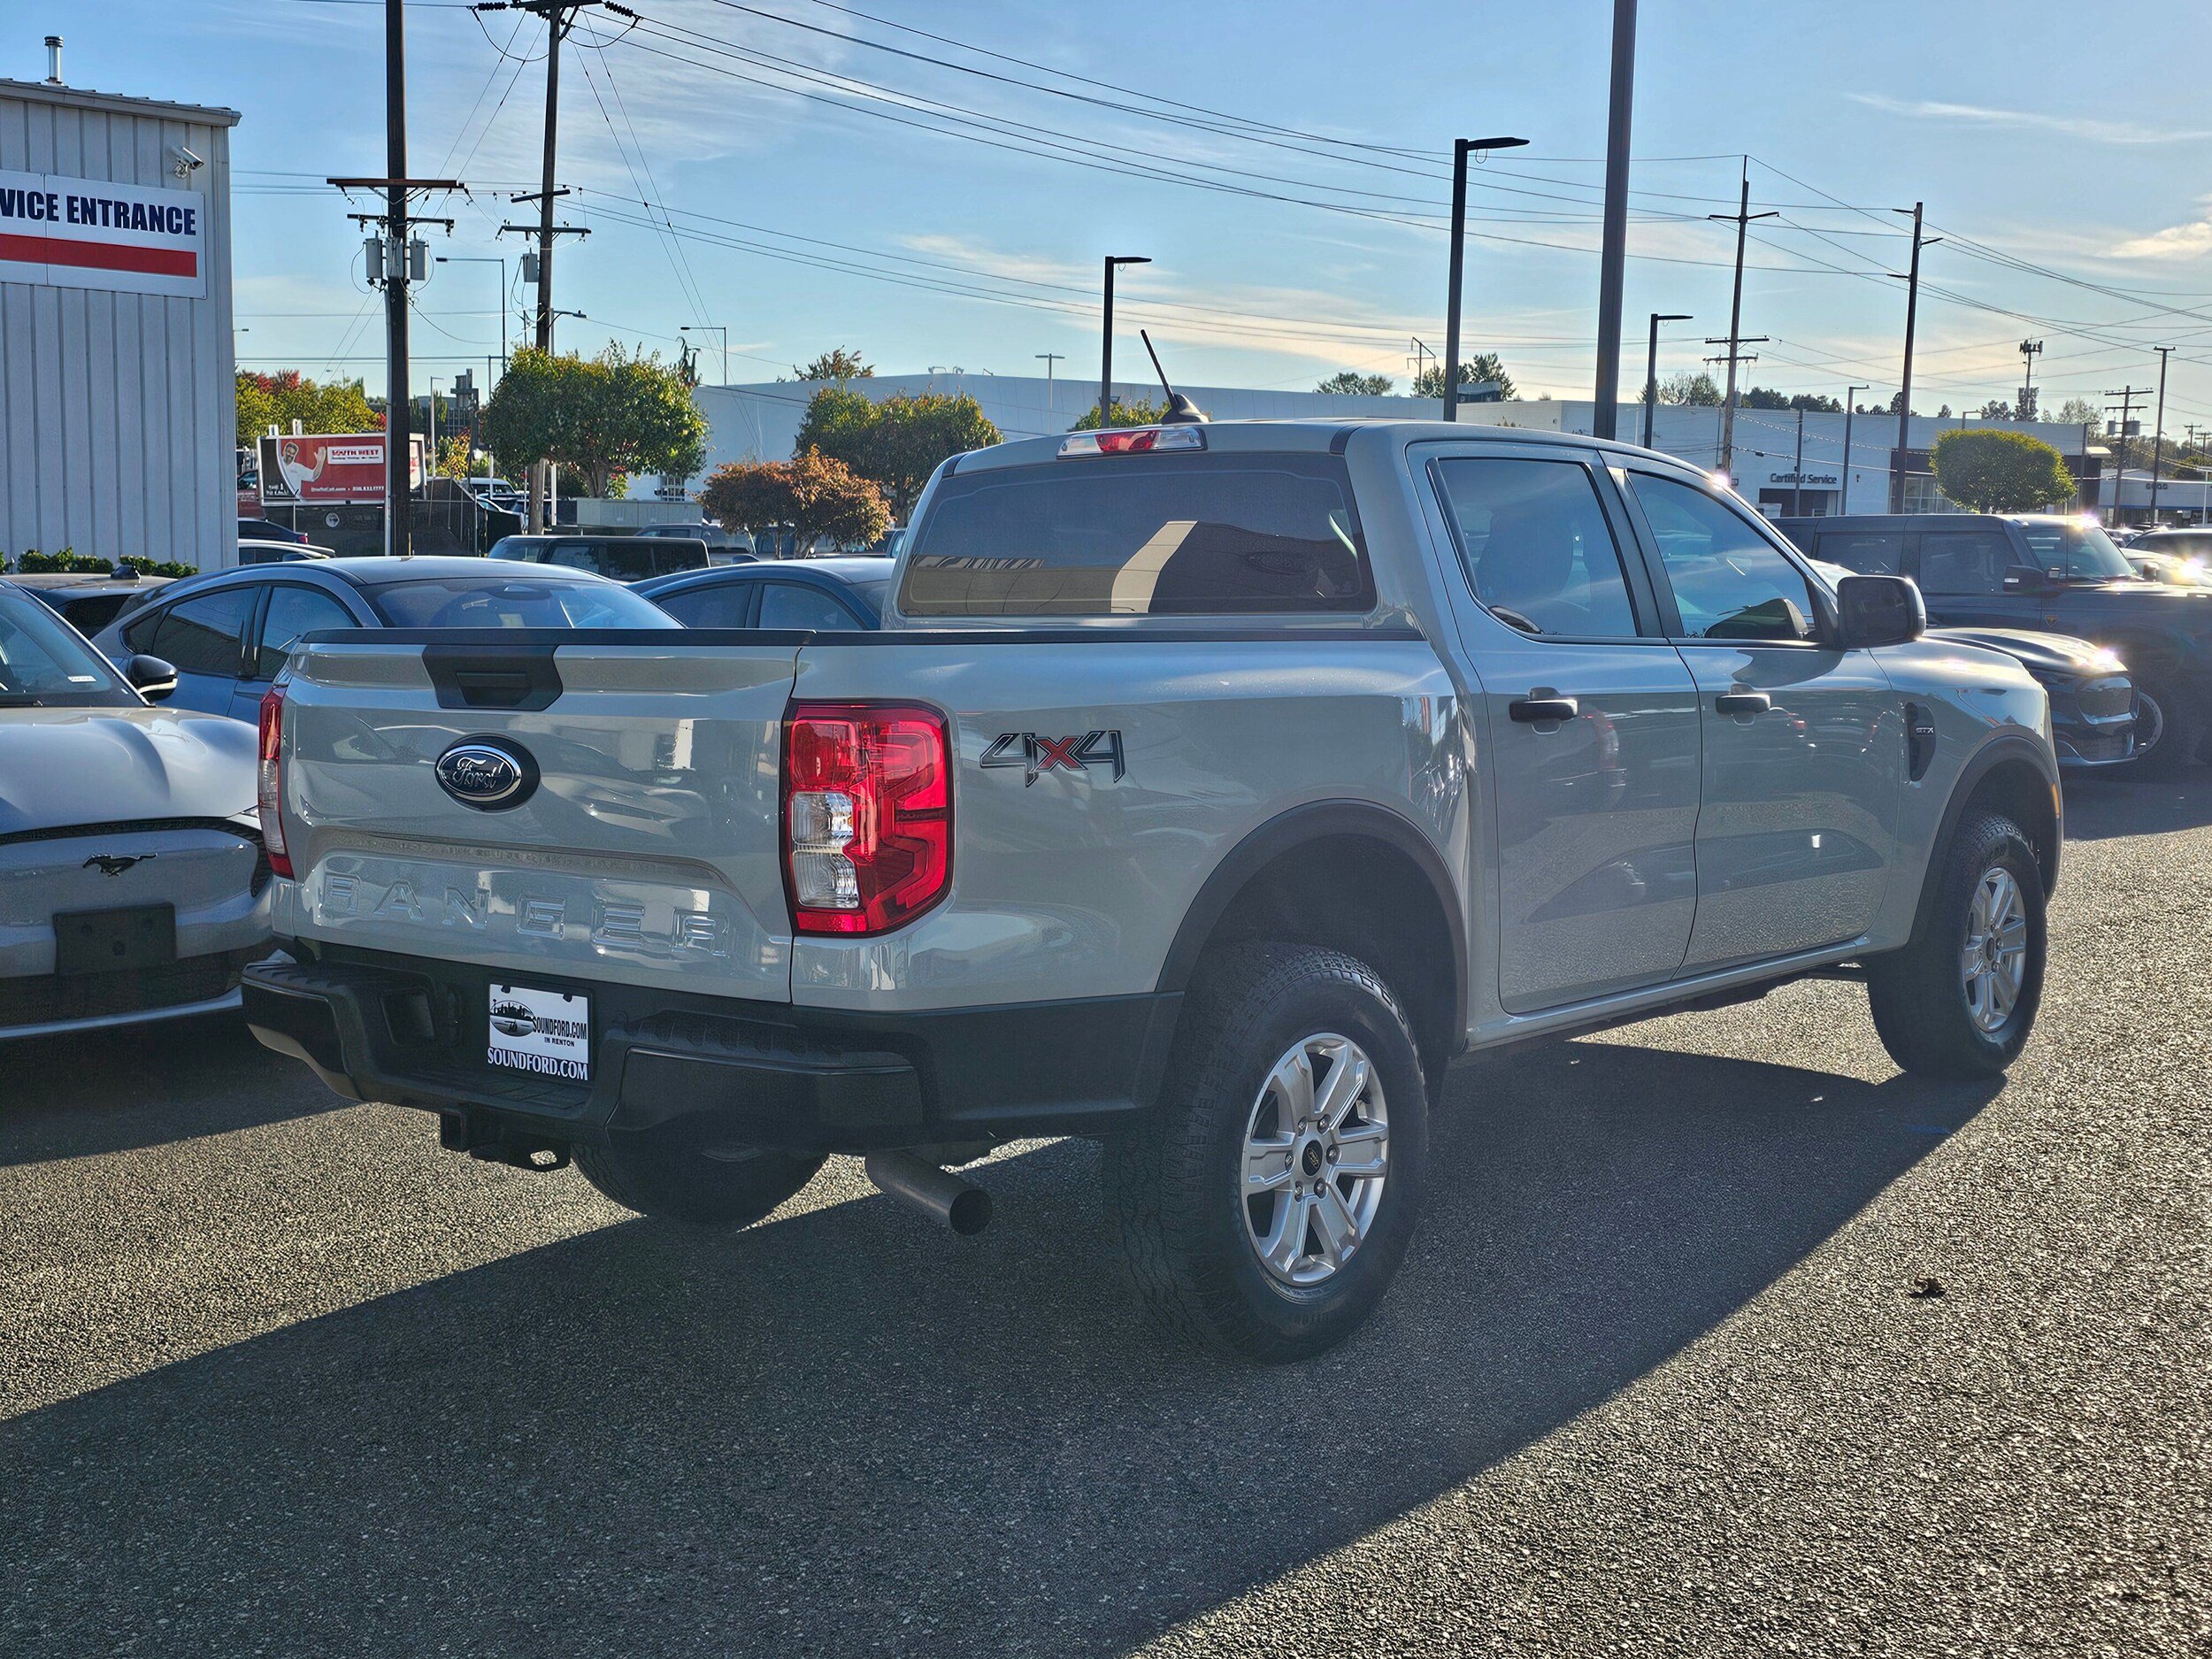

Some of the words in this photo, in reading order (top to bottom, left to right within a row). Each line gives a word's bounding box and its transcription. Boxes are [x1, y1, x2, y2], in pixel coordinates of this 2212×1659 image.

[66, 195, 196, 236] ENTRANCE
[1770, 472, 1806, 484] Certifid
[1807, 473, 1838, 484] Service
[451, 756, 505, 790] Ford
[319, 871, 731, 957] RANGER
[532, 1017, 588, 1041] SOUNDFORD.COM
[551, 1038, 575, 1047] RENTON
[488, 1047, 588, 1081] SOUNDFORD.COM
